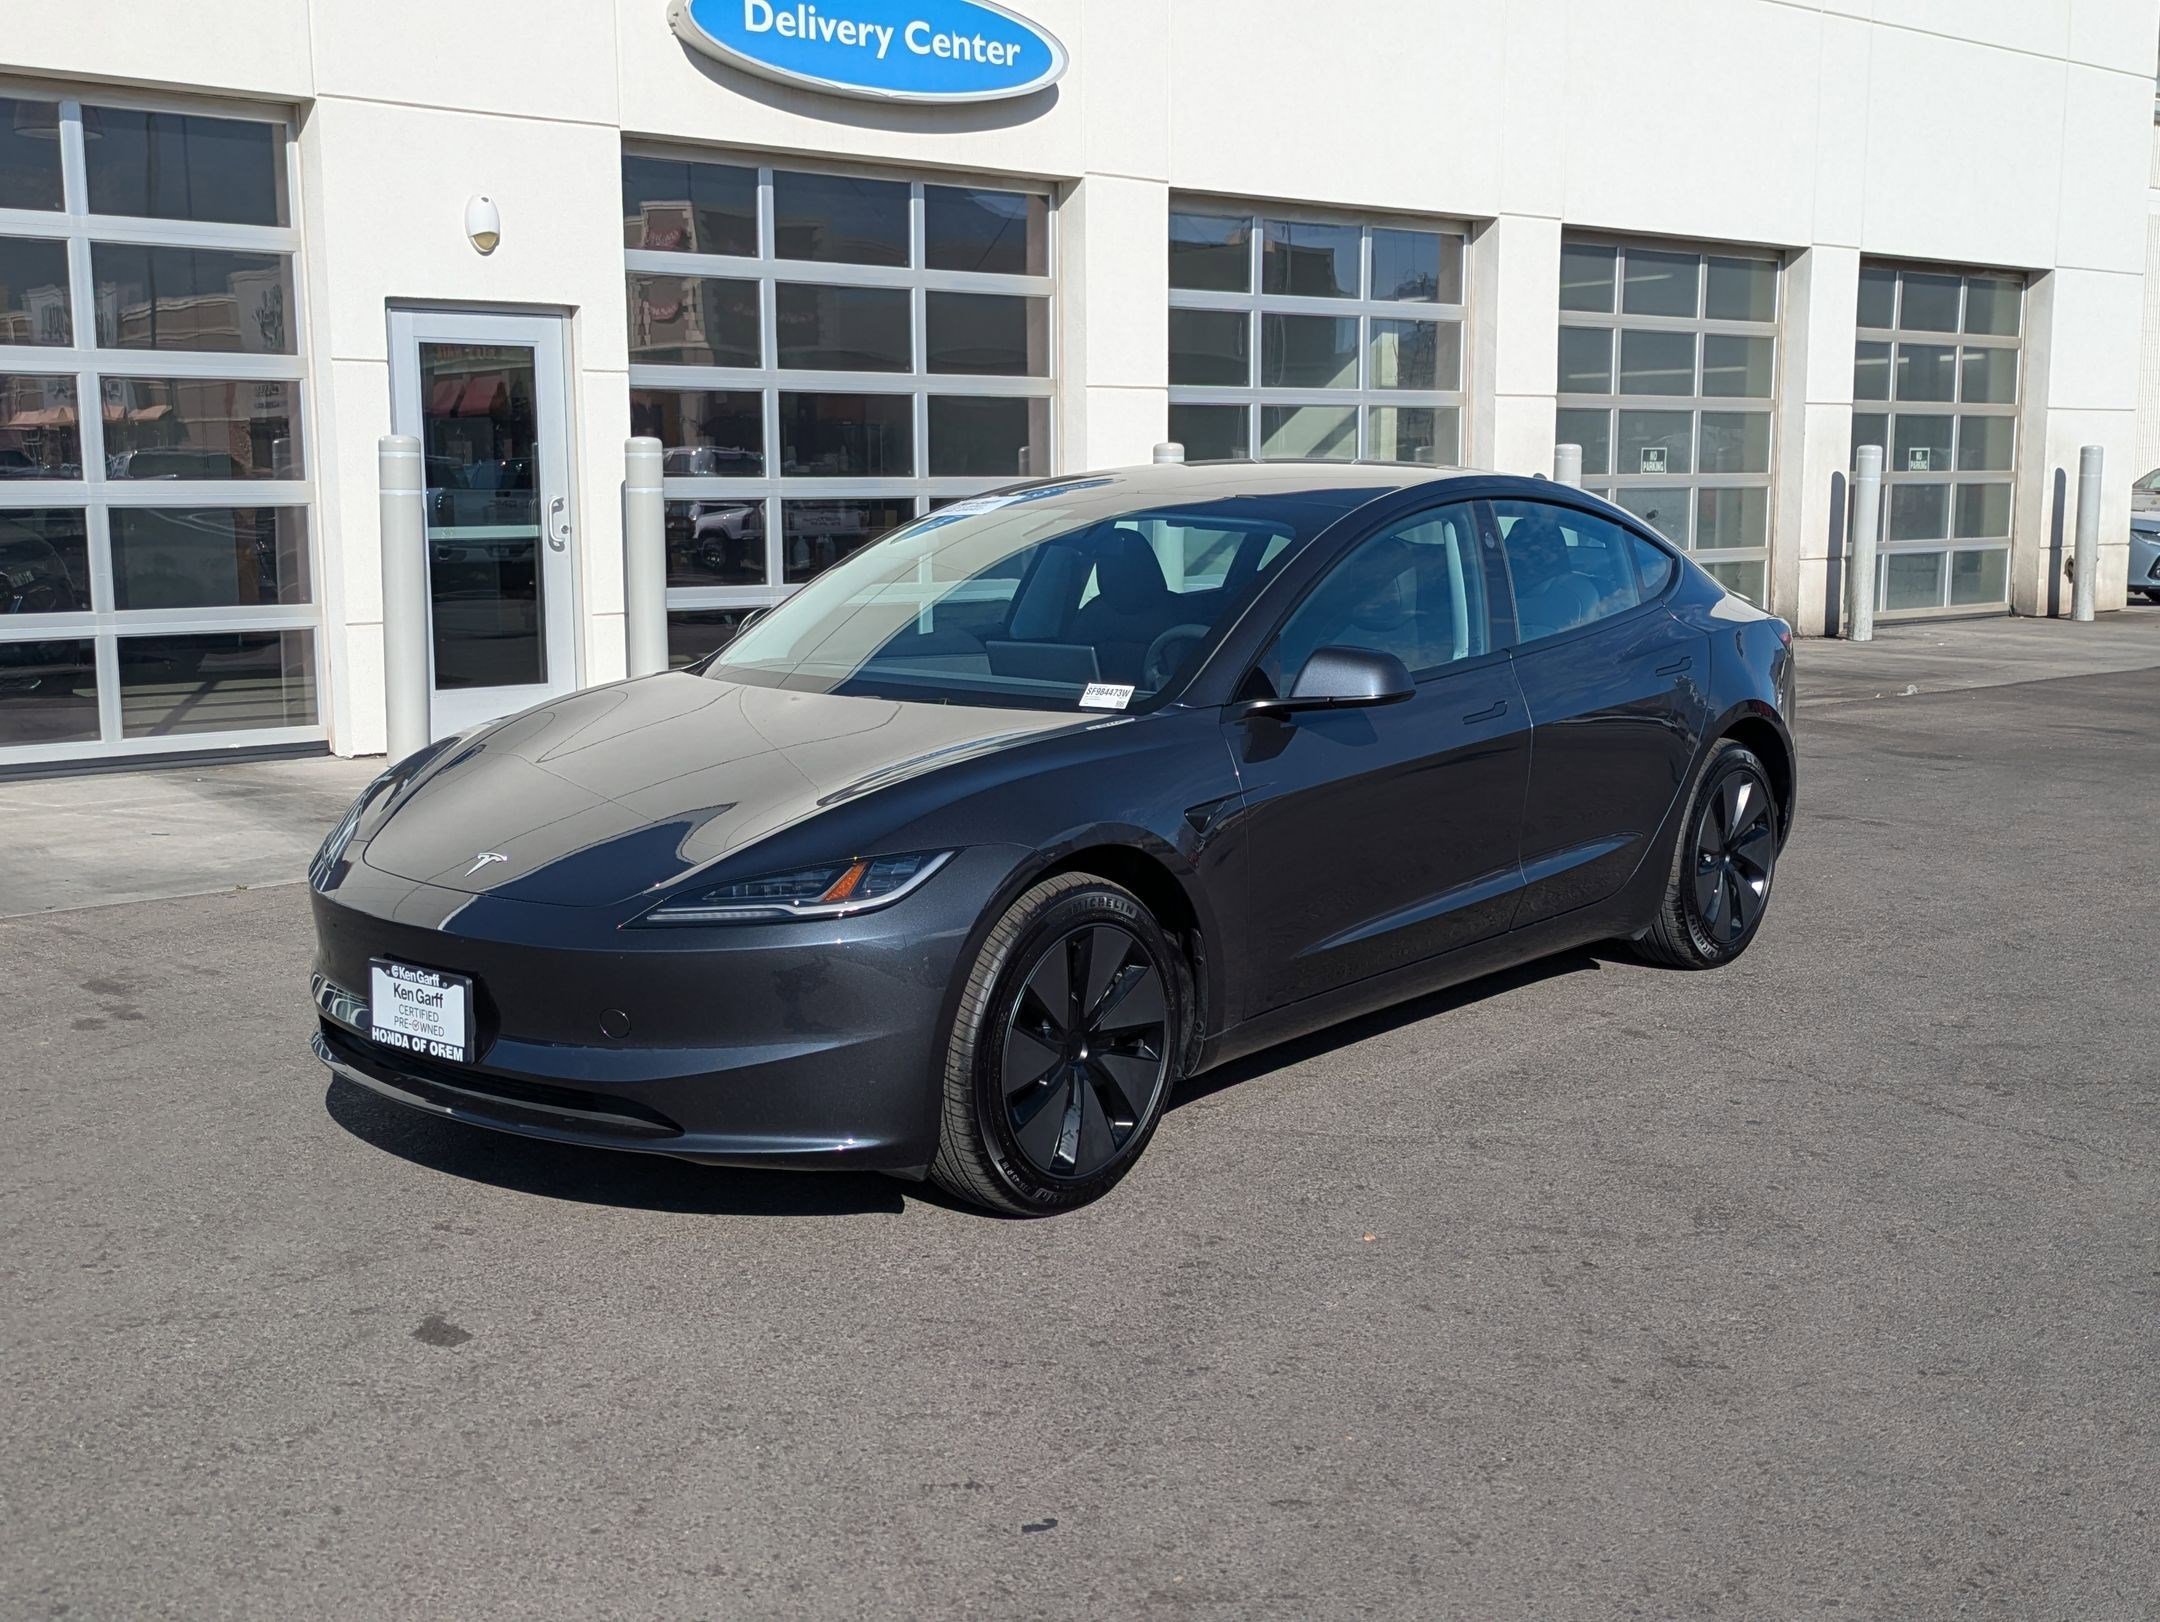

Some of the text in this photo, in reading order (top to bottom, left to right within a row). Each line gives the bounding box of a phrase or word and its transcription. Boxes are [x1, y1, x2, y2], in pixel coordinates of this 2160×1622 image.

[744, 0, 1021, 67] Delivery Center
[1643, 460, 1664, 472] PARKING
[1072, 896, 1137, 918] MICHELIN
[399, 966, 440, 987] Ken Garff
[393, 982, 443, 1009] Ken Garff
[399, 1003, 440, 1023] CERTIFIED
[372, 1027, 464, 1062] HONDA OF OREM
